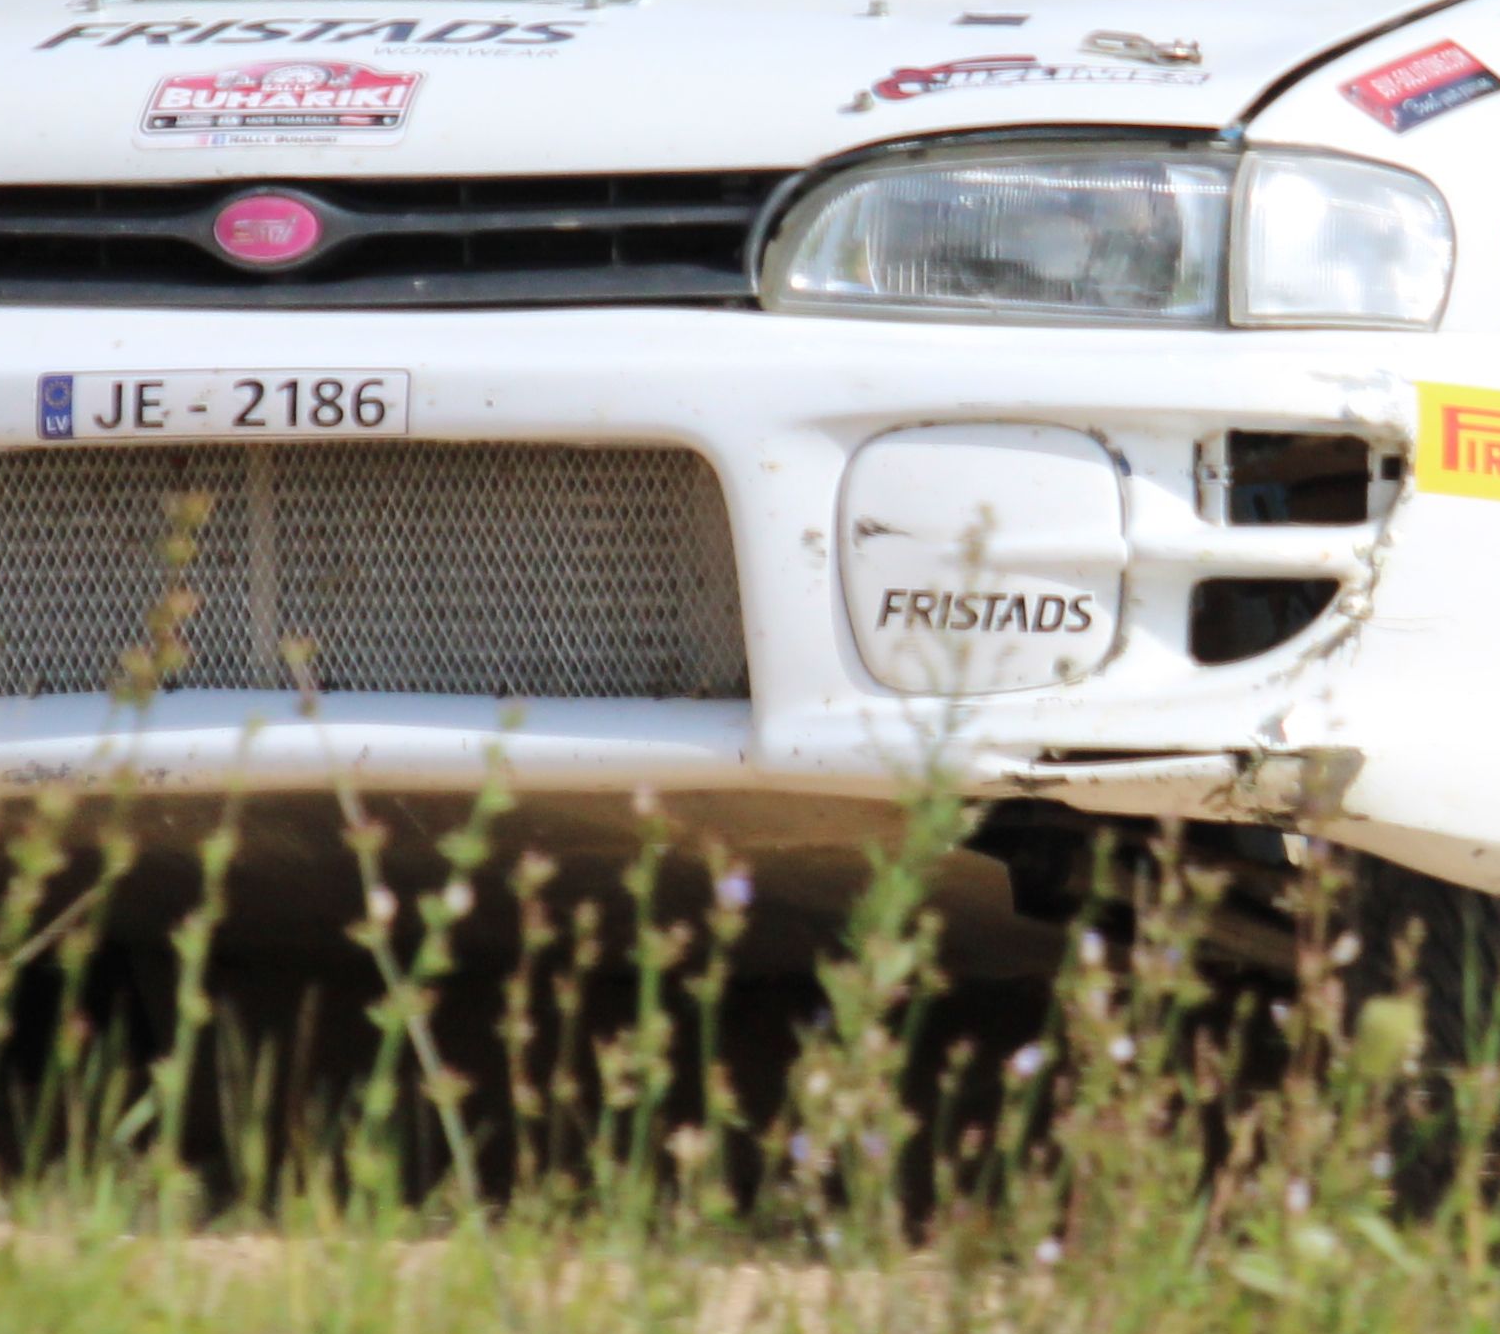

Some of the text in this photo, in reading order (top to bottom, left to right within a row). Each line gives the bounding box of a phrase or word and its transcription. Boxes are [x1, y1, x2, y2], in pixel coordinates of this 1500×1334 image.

[33, 17, 587, 51] FRISTADS
[373, 45, 560, 60] WORKWEAR
[158, 85, 406, 109] BUHARIKI
[45, 414, 70, 434] LV
[875, 587, 1095, 634] FRISTADS
